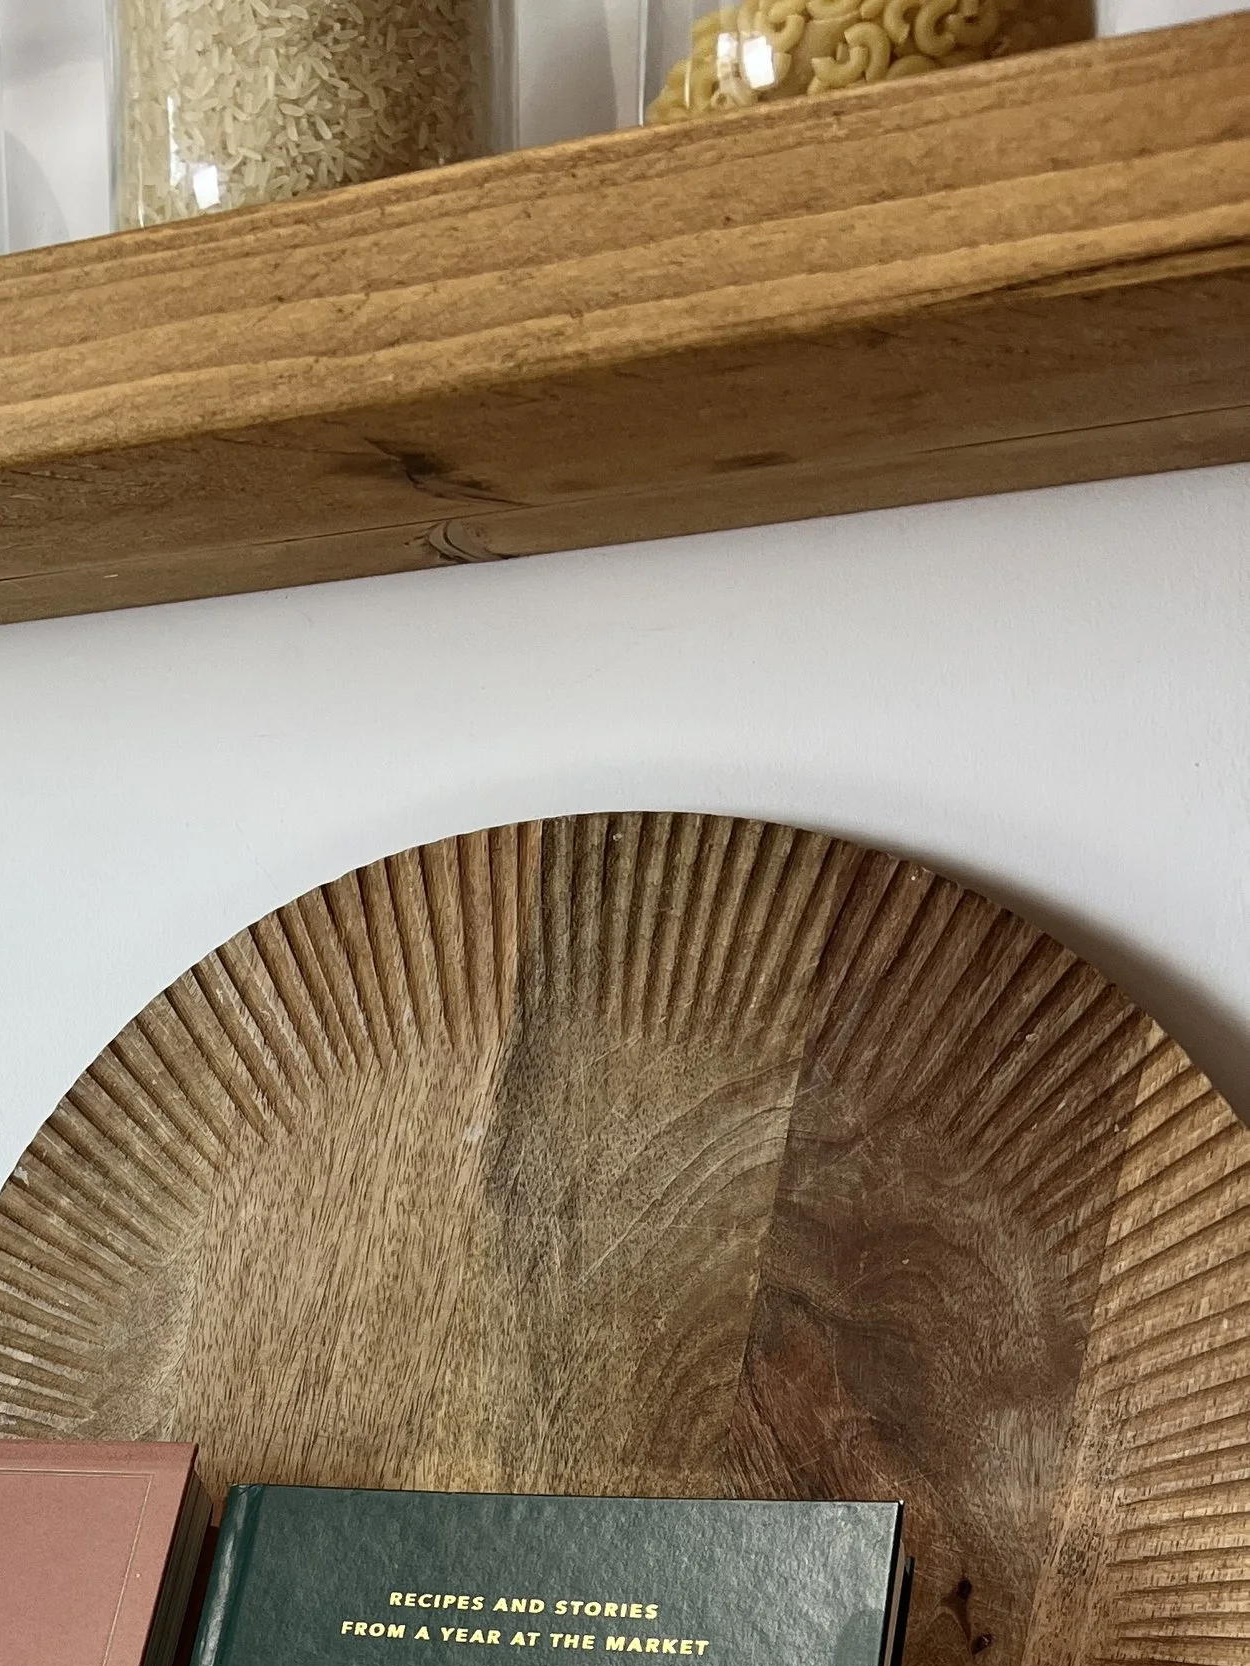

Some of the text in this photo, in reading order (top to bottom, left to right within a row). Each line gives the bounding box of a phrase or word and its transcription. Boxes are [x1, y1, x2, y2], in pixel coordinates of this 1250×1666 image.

[388, 1591, 660, 1620] RECIPES AND STORIES
[340, 1620, 710, 1656] FROM A YEAR AT THE MARKET
